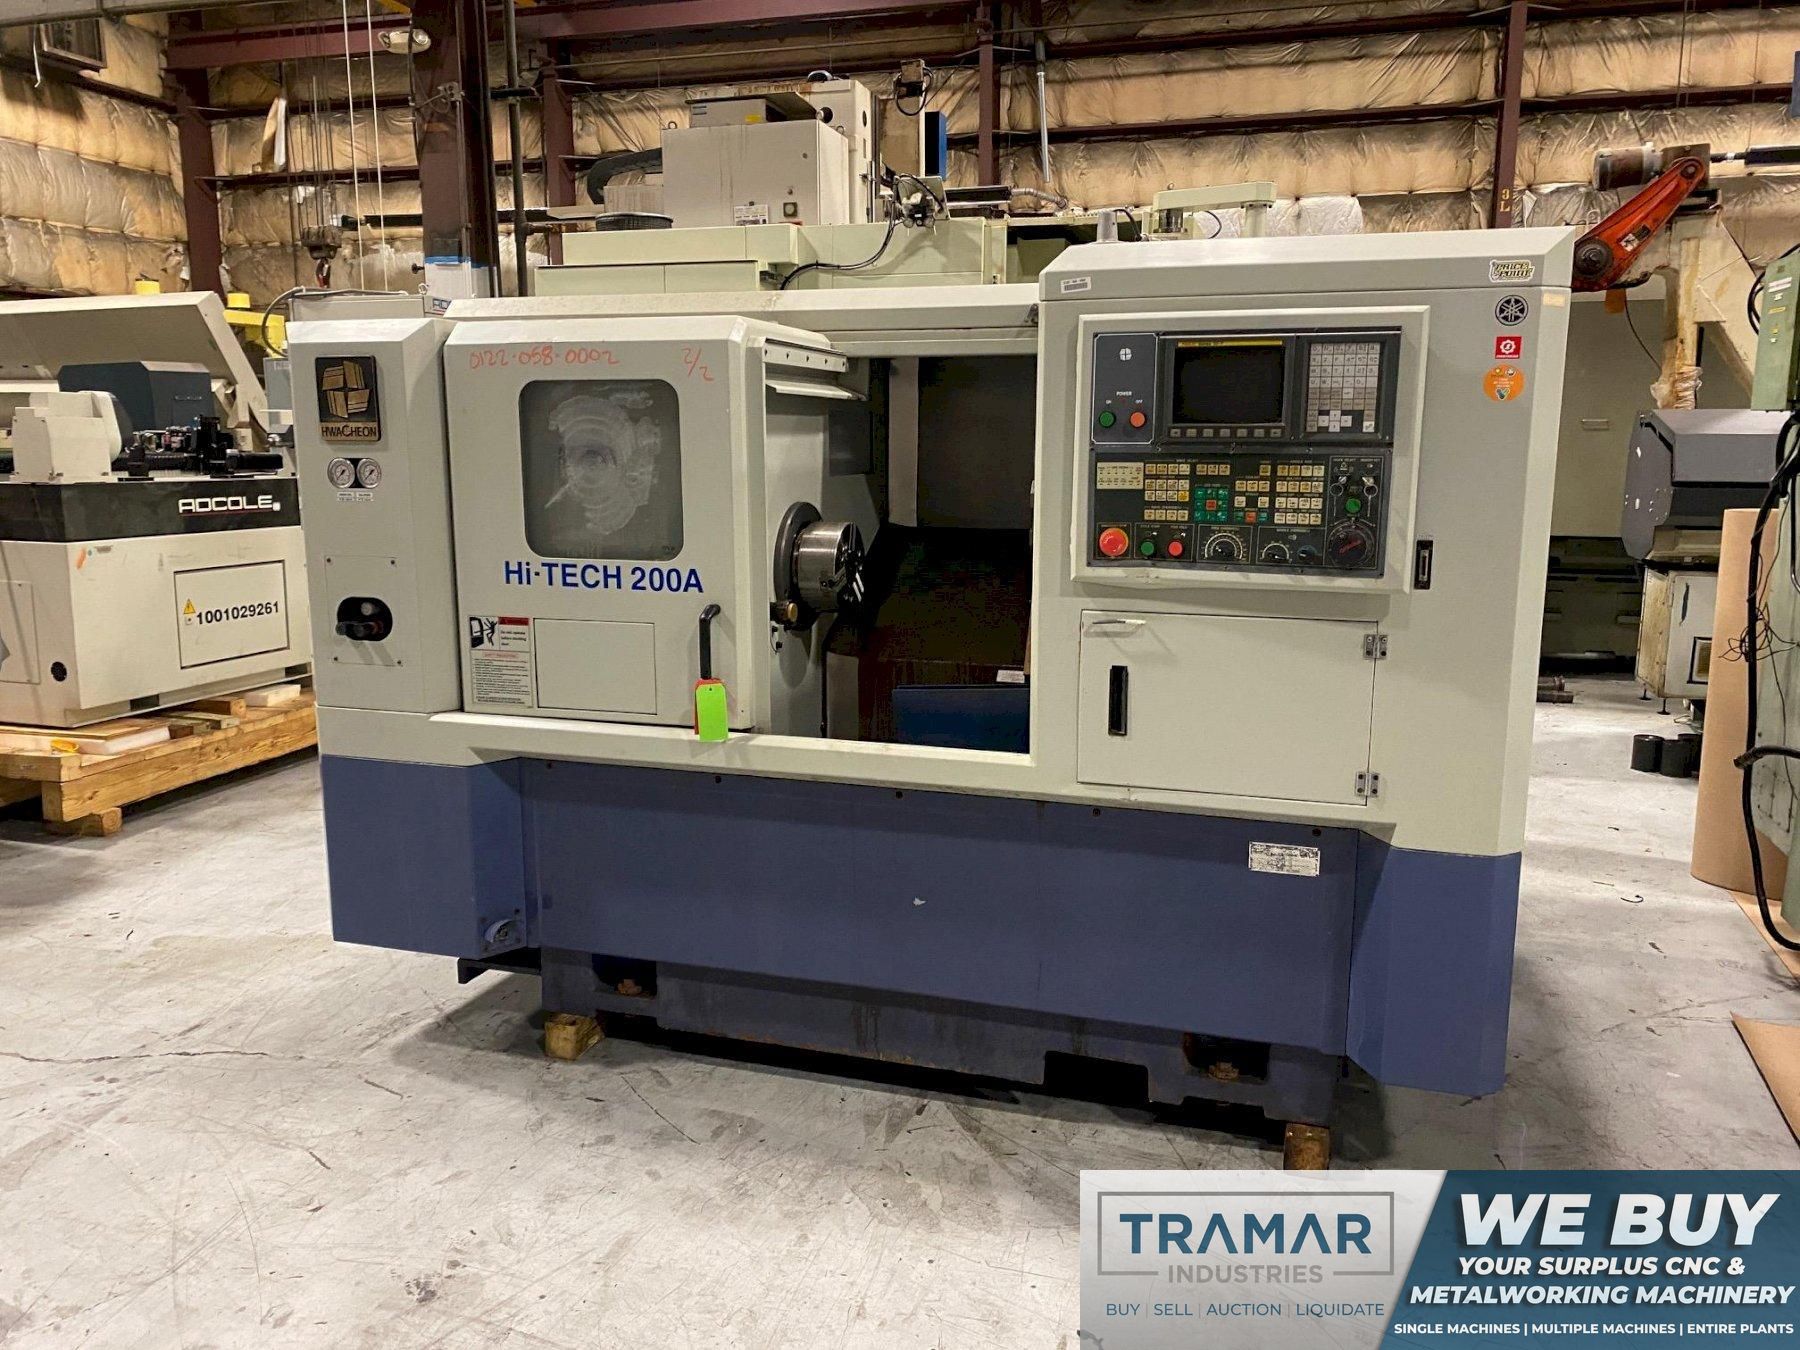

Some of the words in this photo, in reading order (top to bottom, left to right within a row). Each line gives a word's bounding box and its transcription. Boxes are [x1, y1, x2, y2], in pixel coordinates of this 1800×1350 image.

[1500, 201, 1511, 212] L
[321, 425, 377, 437] HWACHEON
[630, 566, 704, 593] 200A
[196, 601, 280, 625] 1001029261
